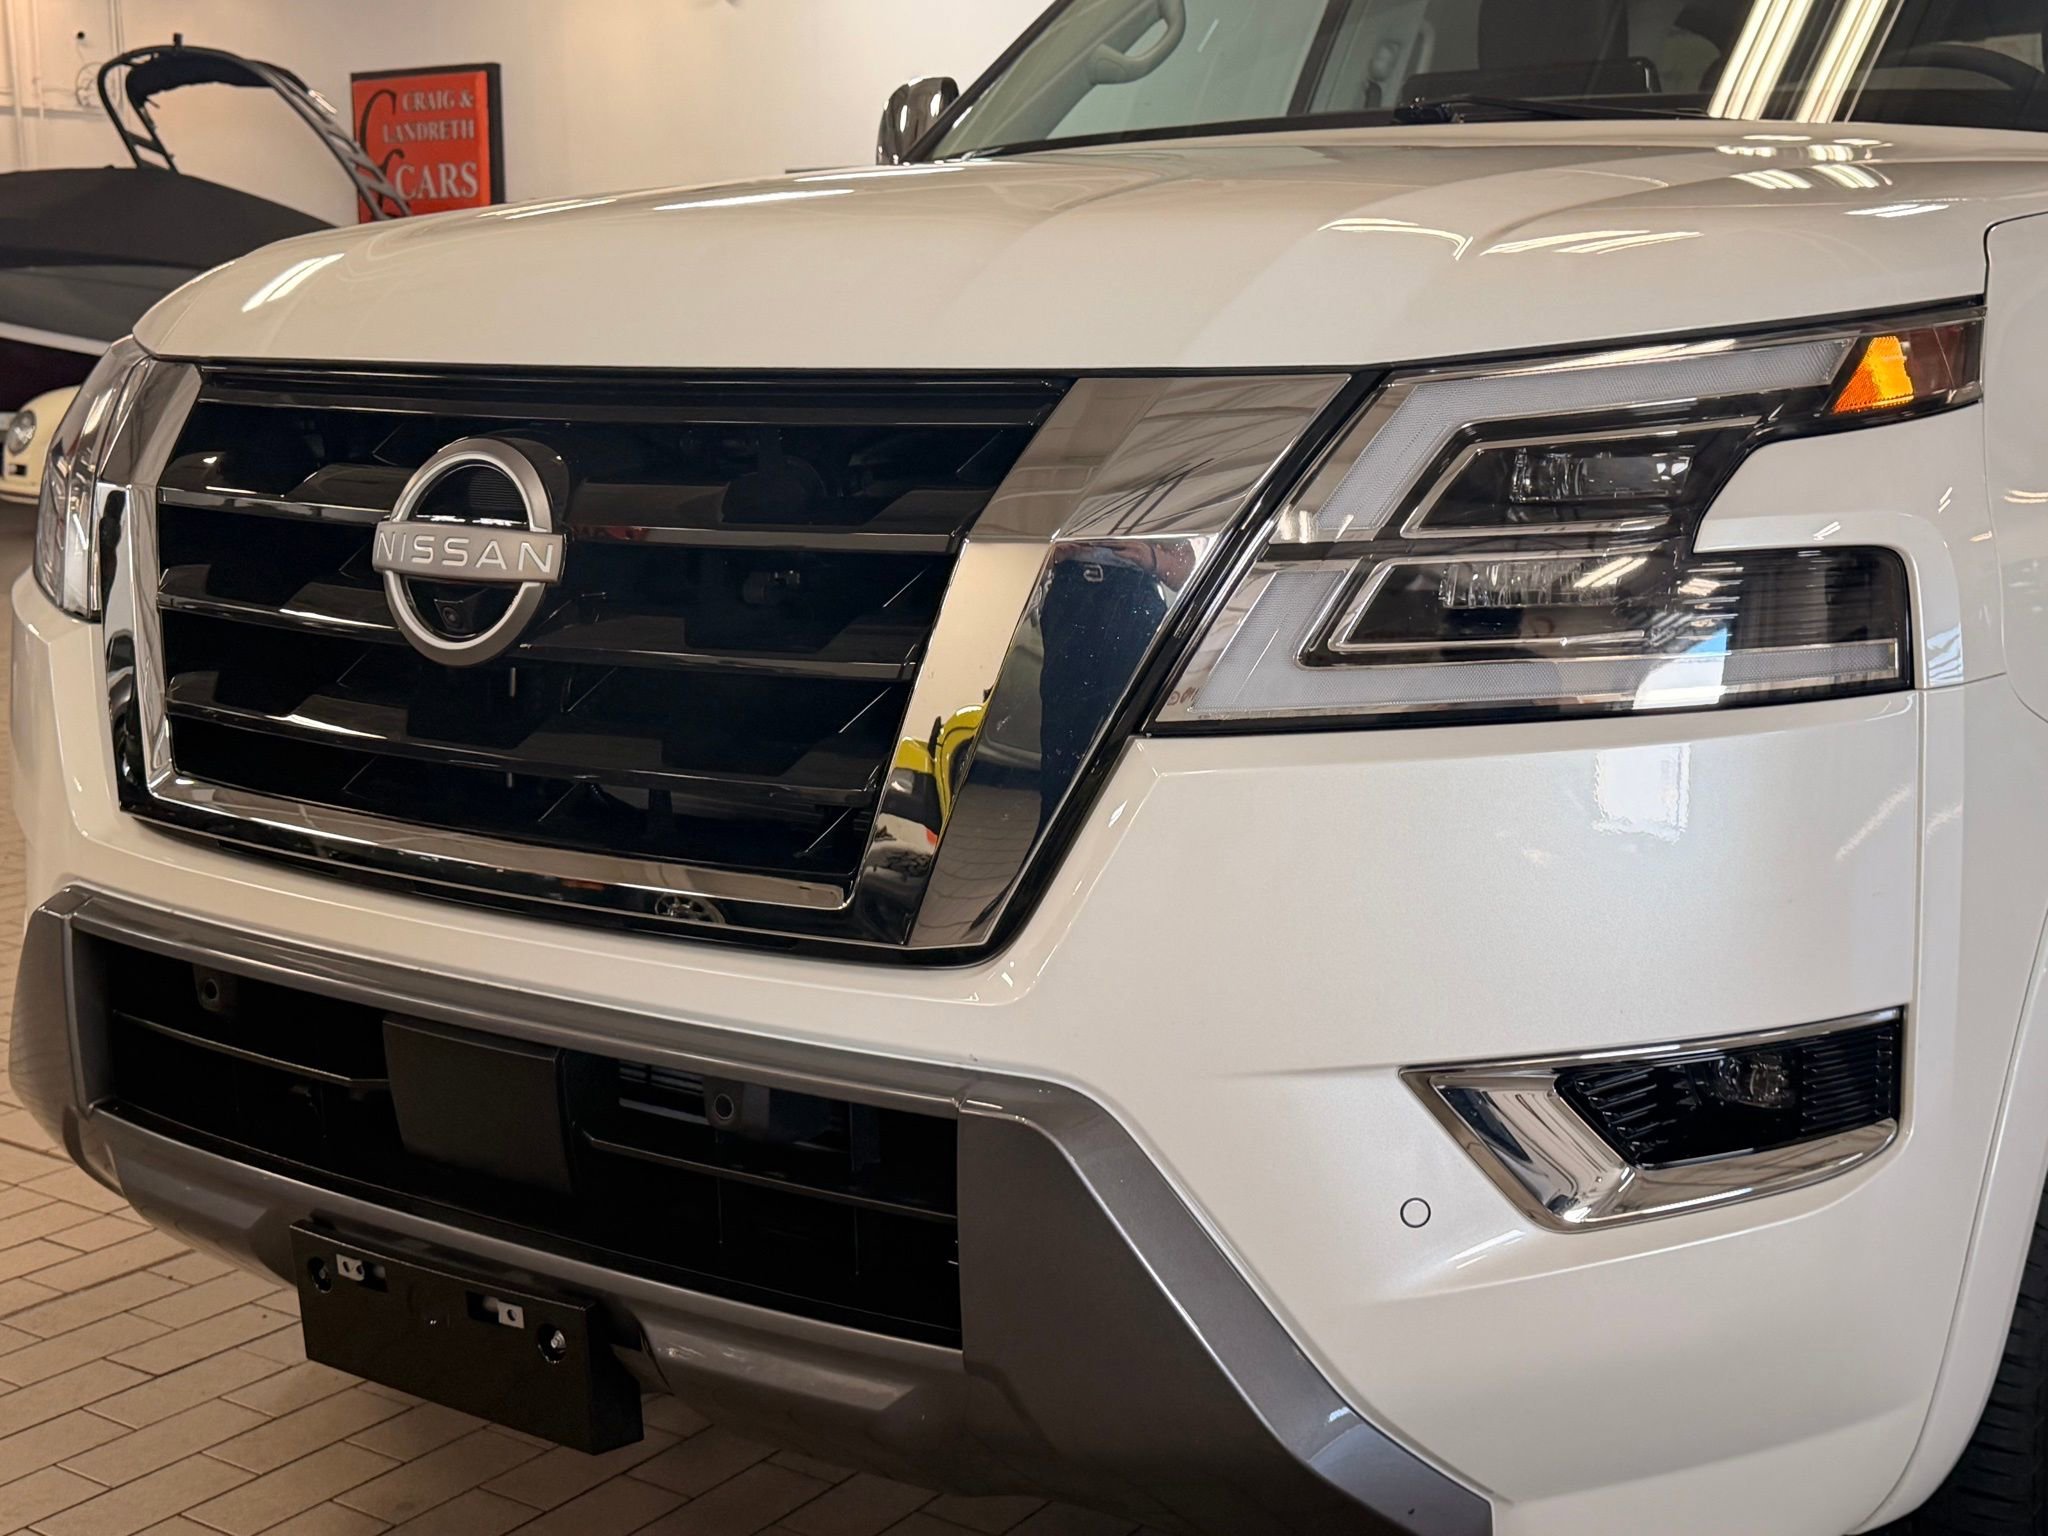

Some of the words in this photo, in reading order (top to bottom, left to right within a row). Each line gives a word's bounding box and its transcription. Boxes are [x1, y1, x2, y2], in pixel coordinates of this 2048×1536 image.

[402, 90, 455, 112] CRAIG
[459, 89, 474, 108] &
[383, 119, 475, 143] LANDRETH
[395, 162, 478, 200] CARS
[377, 531, 553, 573] NISSAN
